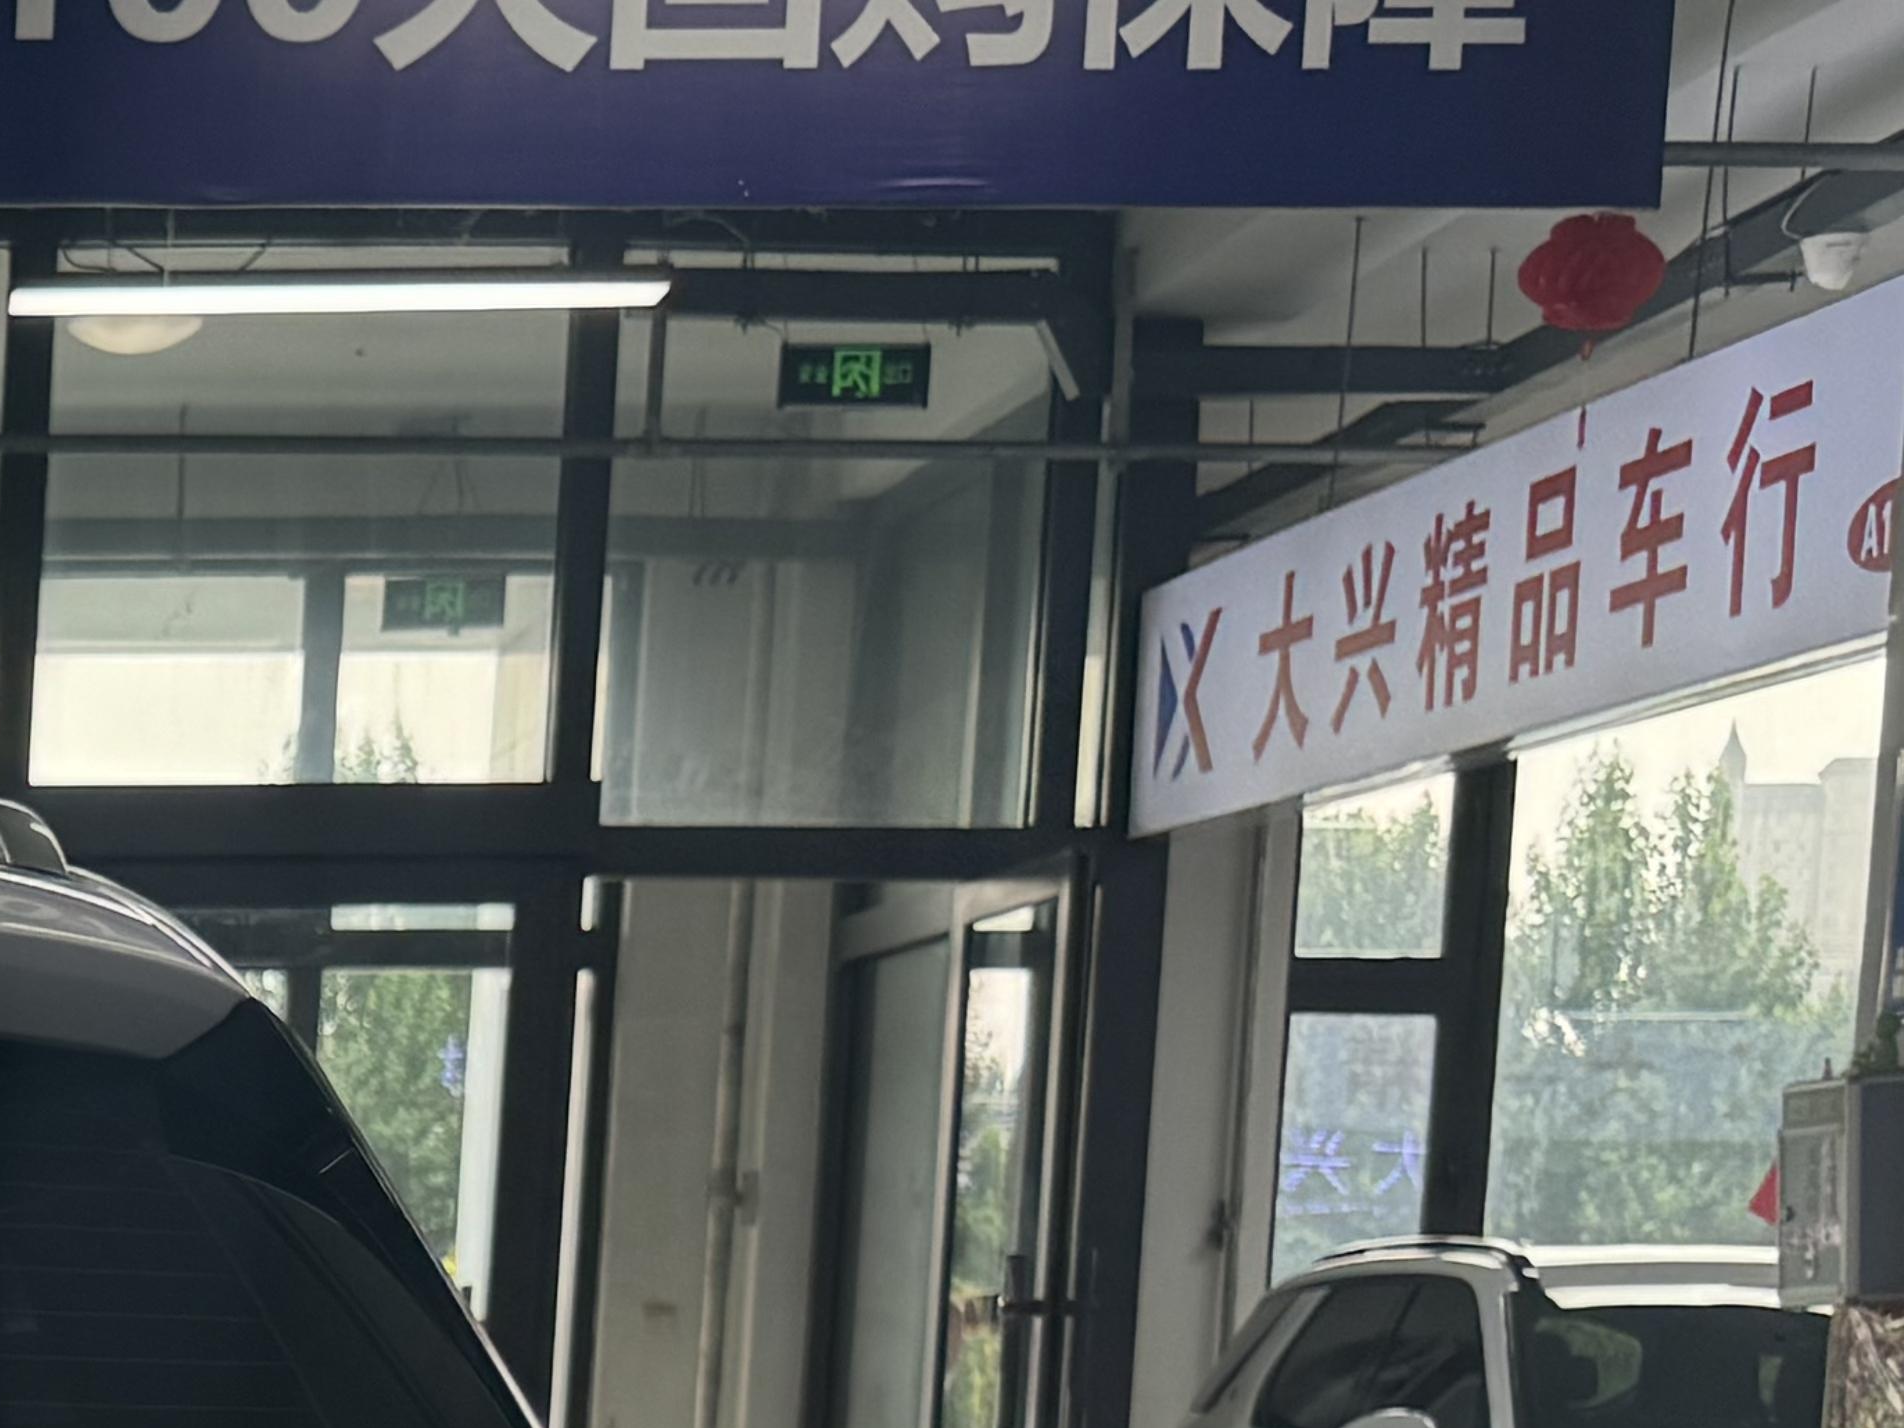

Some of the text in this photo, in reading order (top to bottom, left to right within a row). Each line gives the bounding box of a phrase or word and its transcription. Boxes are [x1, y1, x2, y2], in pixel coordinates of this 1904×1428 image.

[1252, 380, 1816, 763] 大兴精品车行
